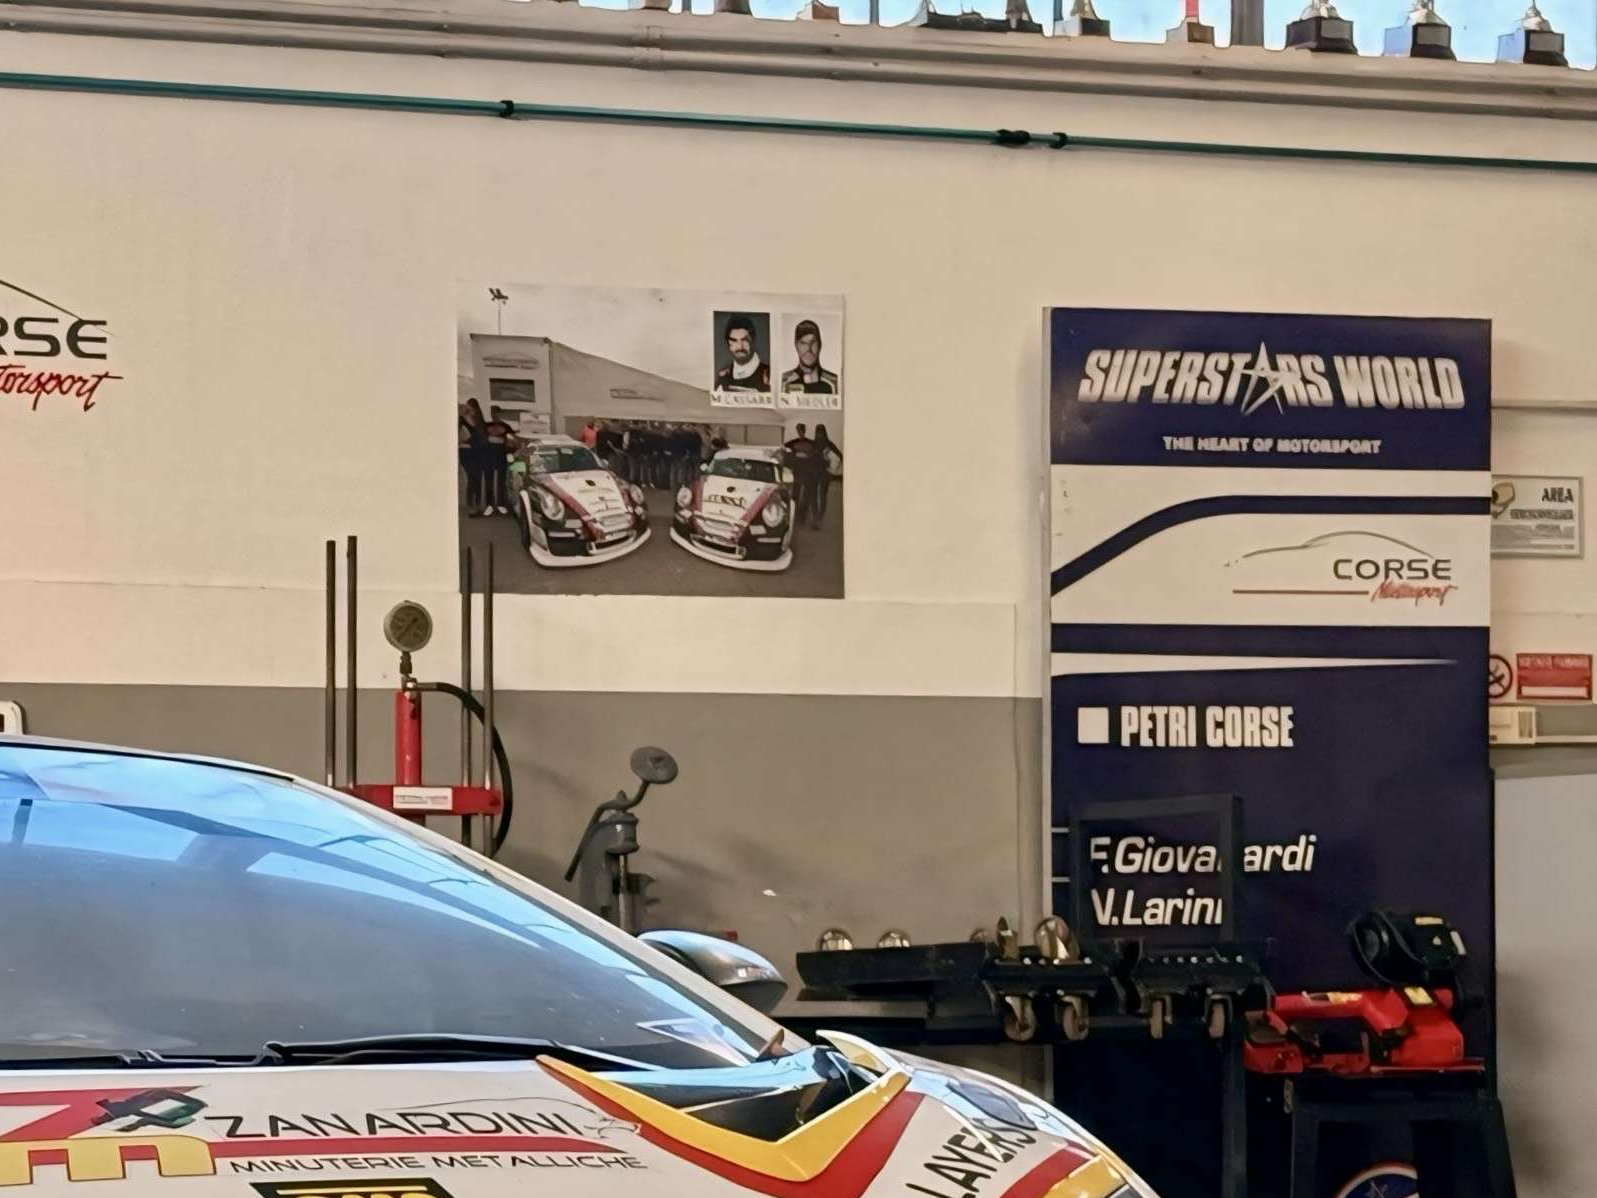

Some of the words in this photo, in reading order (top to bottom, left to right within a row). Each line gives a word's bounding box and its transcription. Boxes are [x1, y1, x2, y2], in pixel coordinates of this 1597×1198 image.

[1333, 355, 1467, 410] WORLD
[1163, 436, 1194, 451] THE
[1198, 437, 1250, 452] HEART
[1253, 438, 1274, 452] OF
[1277, 438, 1382, 454] MOTORSPORT
[1333, 559, 1452, 581] CORSE
[1120, 705, 1197, 748] PETRI
[1205, 705, 1296, 748] CORSE
[1090, 834, 1318, 874] F.Giovaardi
[205, 1110, 584, 1138] ZANARDINI
[230, 1156, 429, 1174] MINUTERIE
[433, 1153, 651, 1171] METALLICHE
